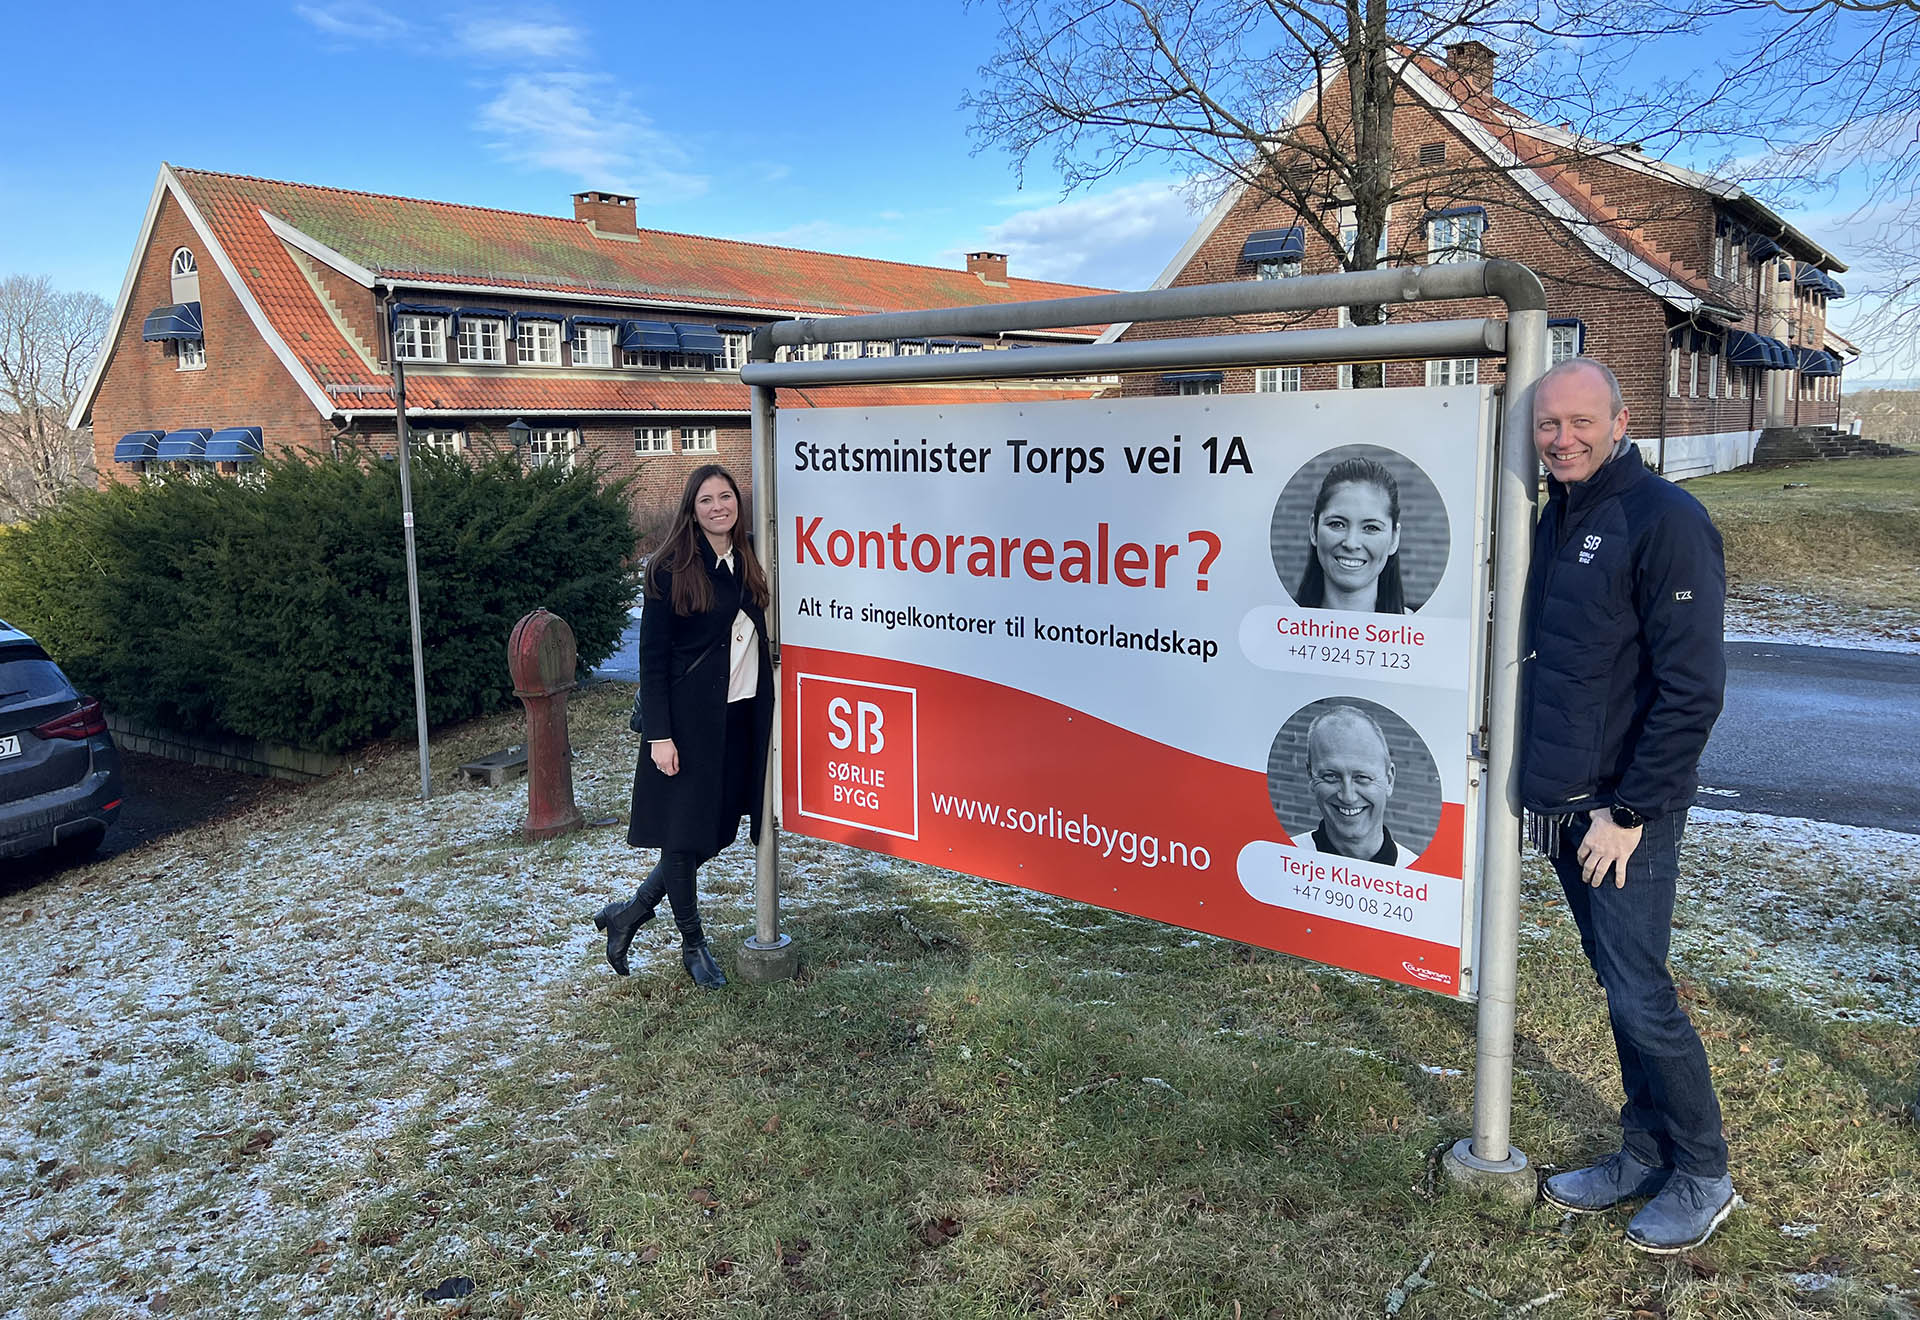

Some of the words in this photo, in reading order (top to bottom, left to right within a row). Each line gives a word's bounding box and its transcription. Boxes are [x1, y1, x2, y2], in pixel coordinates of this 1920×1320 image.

[794, 439, 992, 473] Statsminister
[1006, 439, 1105, 483] Torps
[1124, 435, 1182, 475] vei
[1201, 436, 1254, 474] 1A
[795, 516, 1222, 592] Kontorarealer?
[798, 597, 822, 617] Alt
[829, 600, 853, 621] fra
[861, 602, 996, 635] singelkontorer
[1005, 616, 1025, 638] til
[1034, 617, 1218, 662] kontorlandskap
[1277, 617, 1359, 640] Cathrine
[1365, 624, 1425, 646] Sørlie
[1288, 645, 1316, 660] +47
[1321, 647, 1350, 663] 924
[1355, 650, 1375, 666] 57
[1380, 652, 1411, 670] 123
[828, 761, 885, 788] SØRLIE
[833, 784, 879, 810] BYGG
[931, 792, 1211, 871] www.sorliebygg.no
[1280, 856, 1326, 881] Terje
[1331, 866, 1428, 902] Klavestad
[1292, 884, 1321, 901] +47
[1325, 890, 1354, 909] 990
[1359, 897, 1378, 915] 08
[1383, 902, 1413, 922] 240
